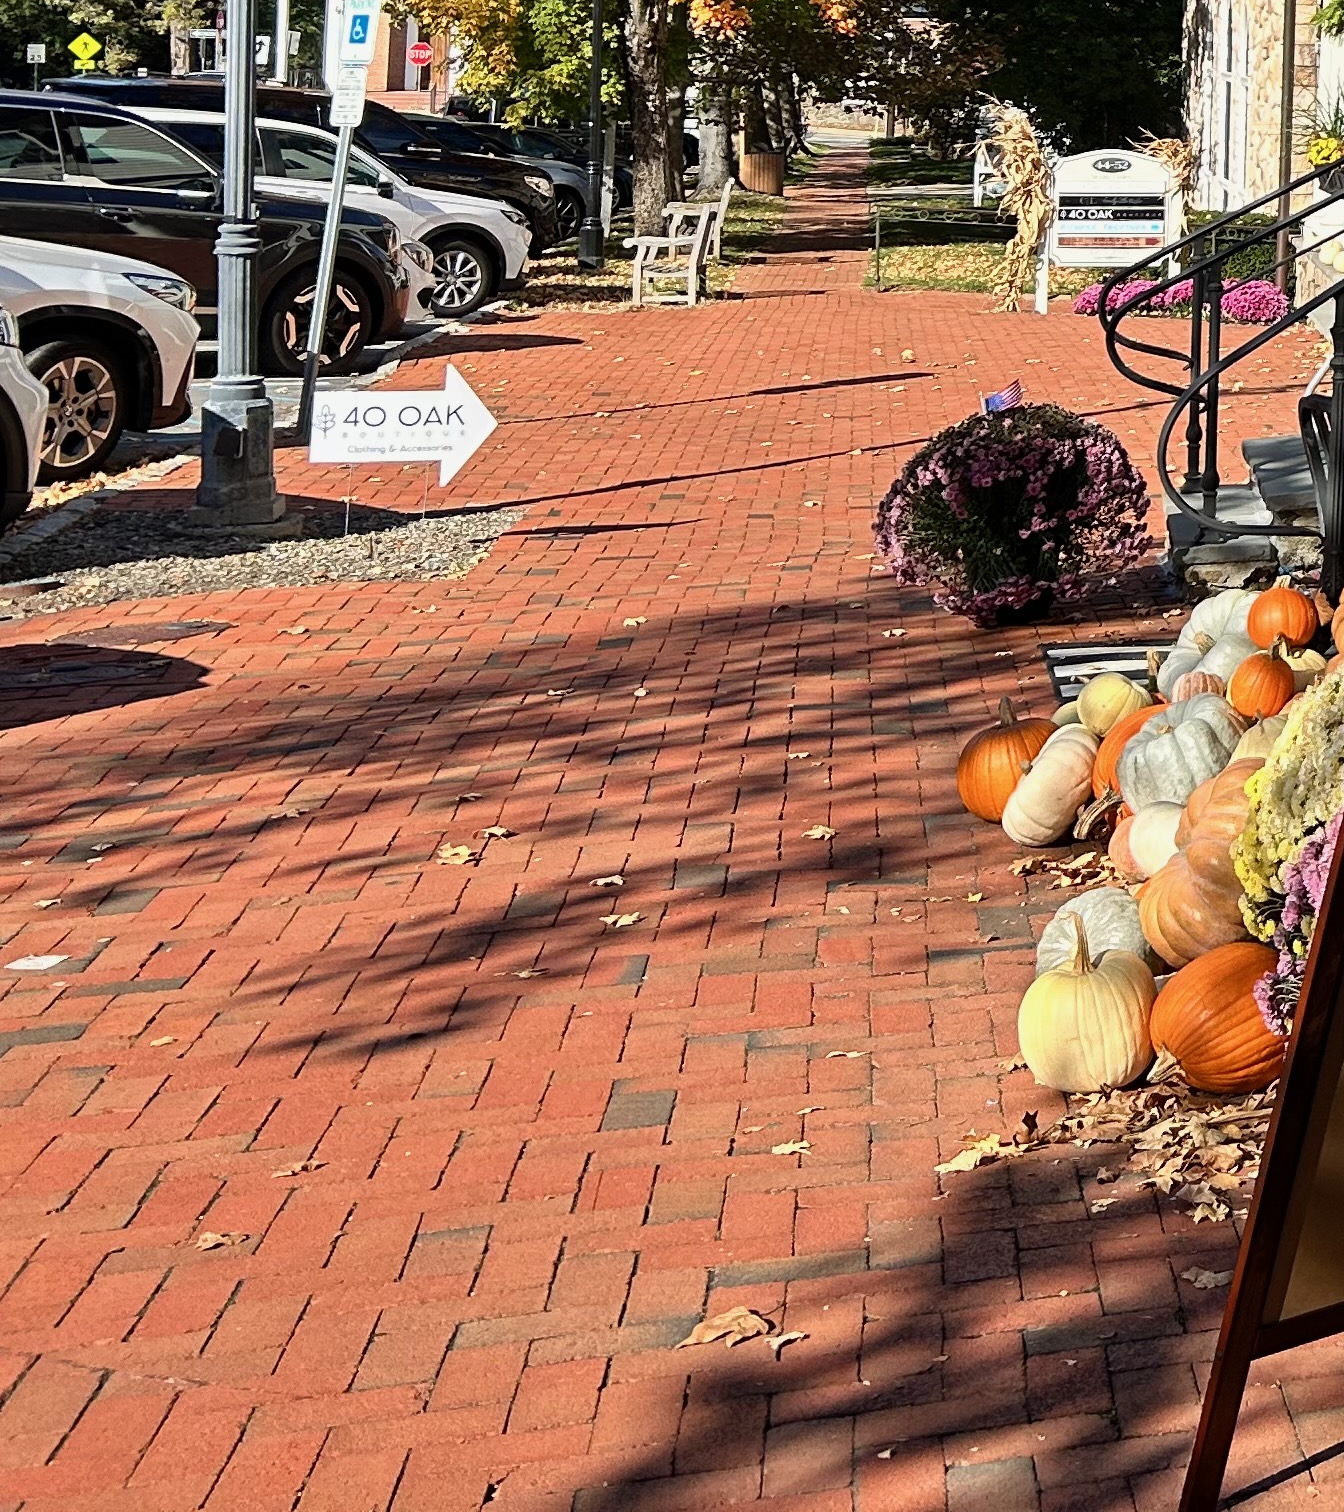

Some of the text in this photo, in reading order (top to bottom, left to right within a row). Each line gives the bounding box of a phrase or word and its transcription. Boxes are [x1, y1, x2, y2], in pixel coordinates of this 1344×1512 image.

[409, 49, 433, 60] STOP
[1068, 210, 1086, 220] 40
[1087, 209, 1114, 220] OAK
[343, 405, 465, 427] 40 OAK
[347, 444, 454, 455] Clothing & Accessories
